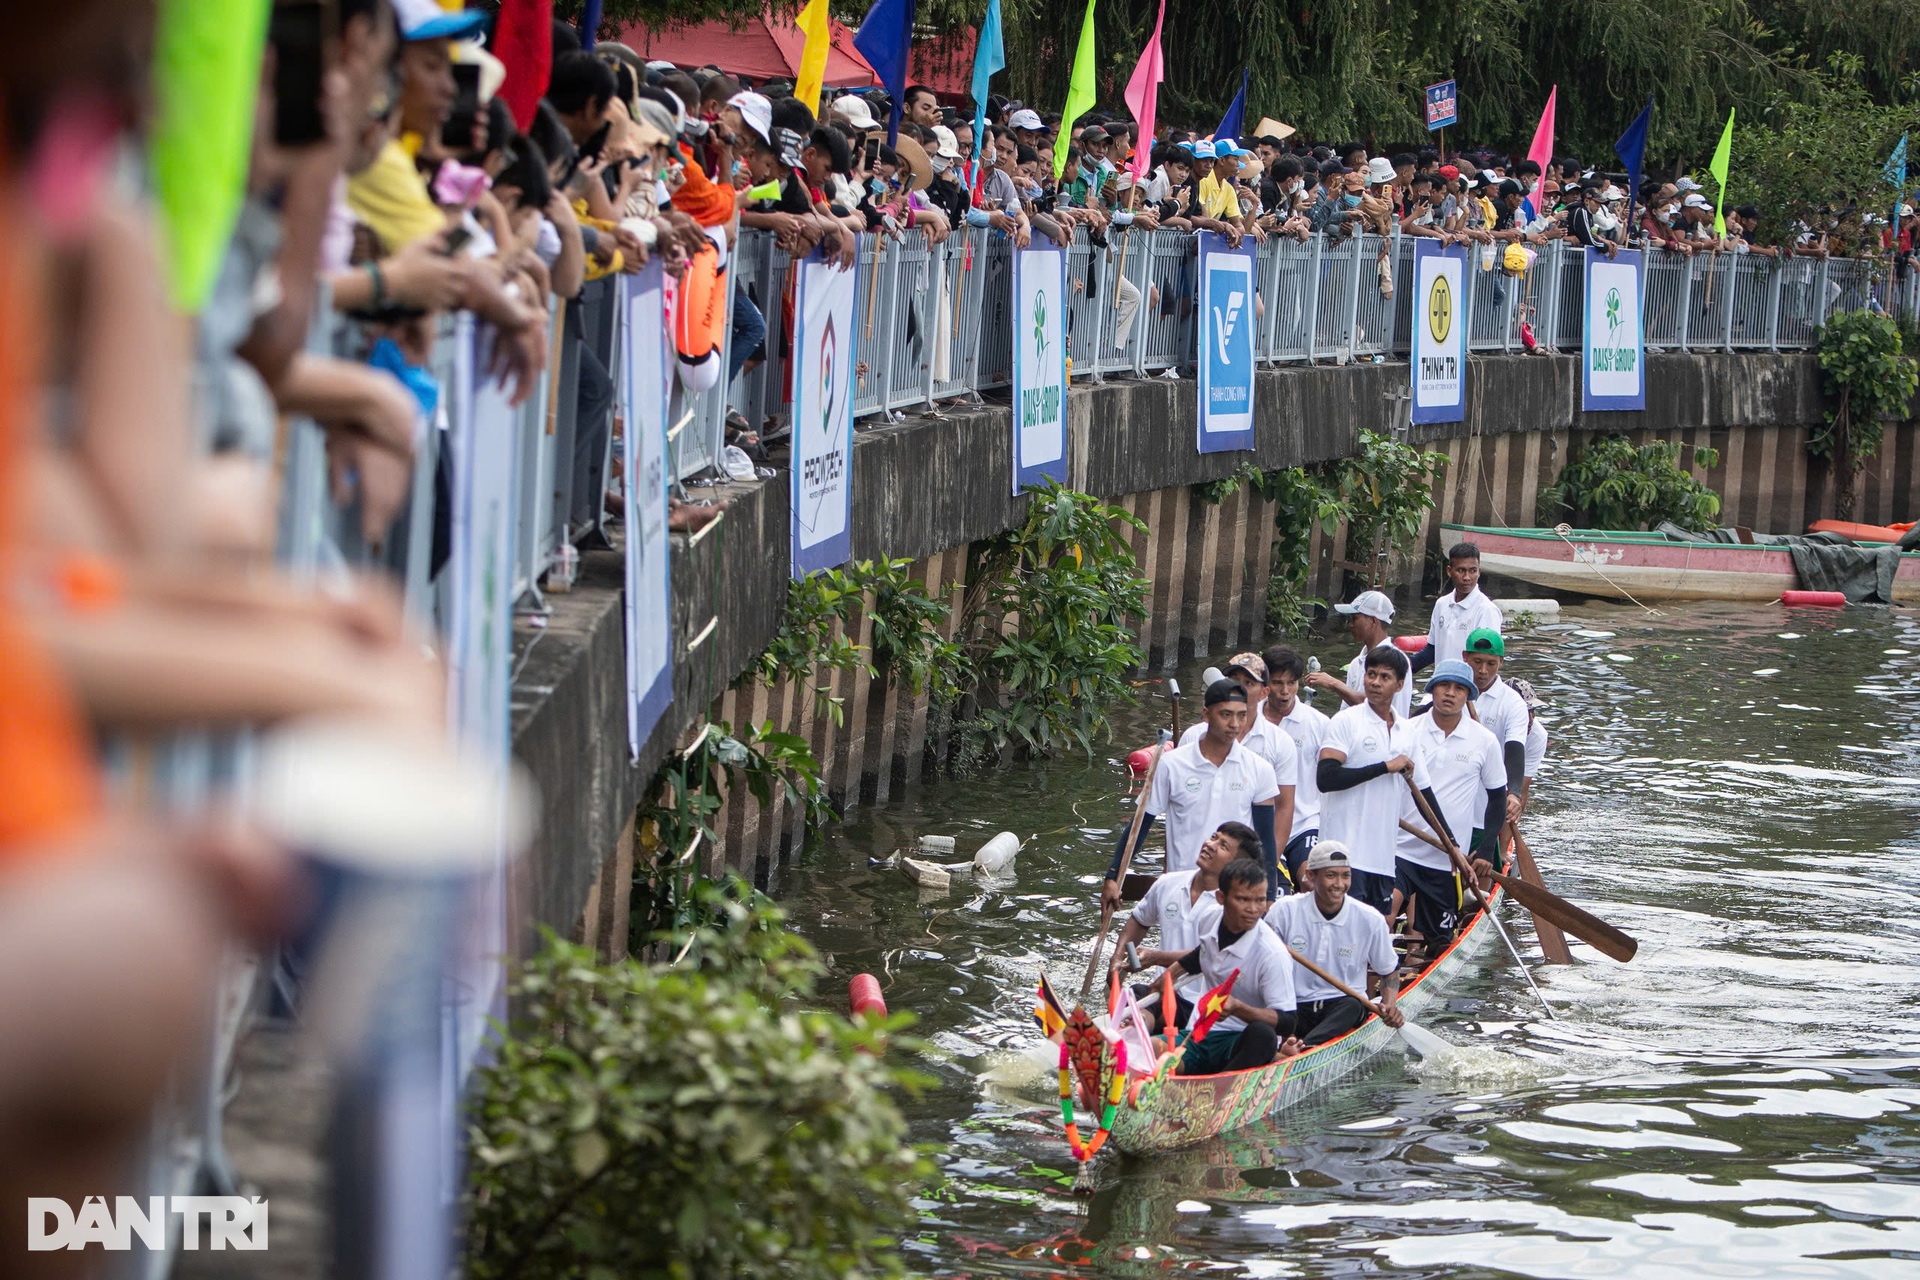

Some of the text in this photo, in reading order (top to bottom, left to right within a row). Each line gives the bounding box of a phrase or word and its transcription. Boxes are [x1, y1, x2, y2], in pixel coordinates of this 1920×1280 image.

[1593, 348, 1635, 371] DAISY GROUP
[1023, 385, 1059, 428] DAISY GROUP
[1305, 835, 1319, 848] 18
